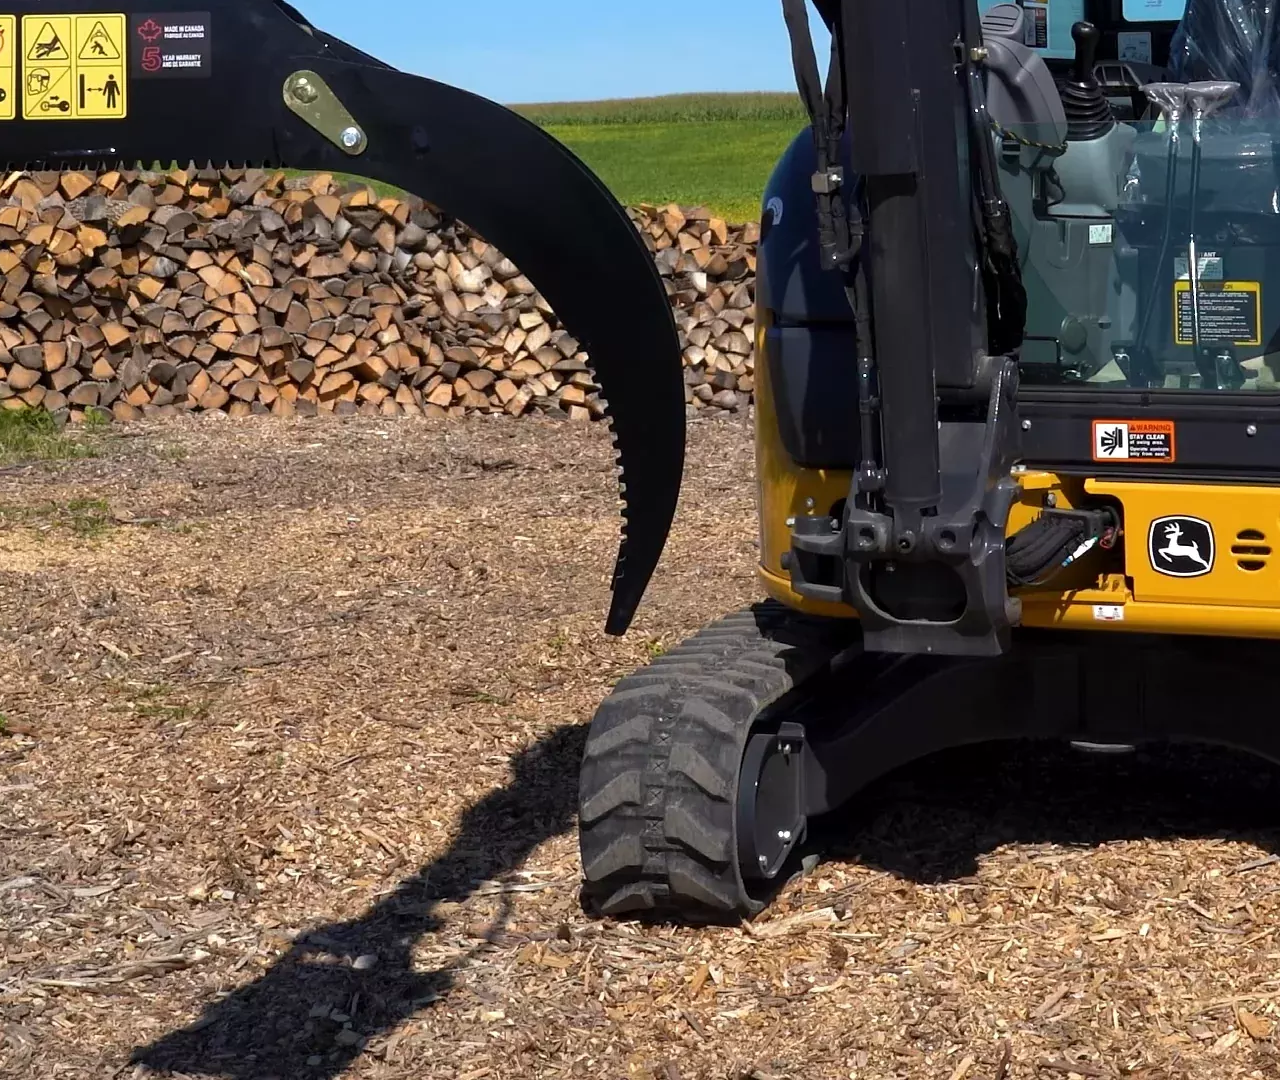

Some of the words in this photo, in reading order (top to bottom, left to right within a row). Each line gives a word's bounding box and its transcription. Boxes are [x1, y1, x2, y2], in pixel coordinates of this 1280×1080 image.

[164, 25, 178, 33] MADE
[184, 24, 205, 32] CANADA
[141, 46, 162, 71] 5
